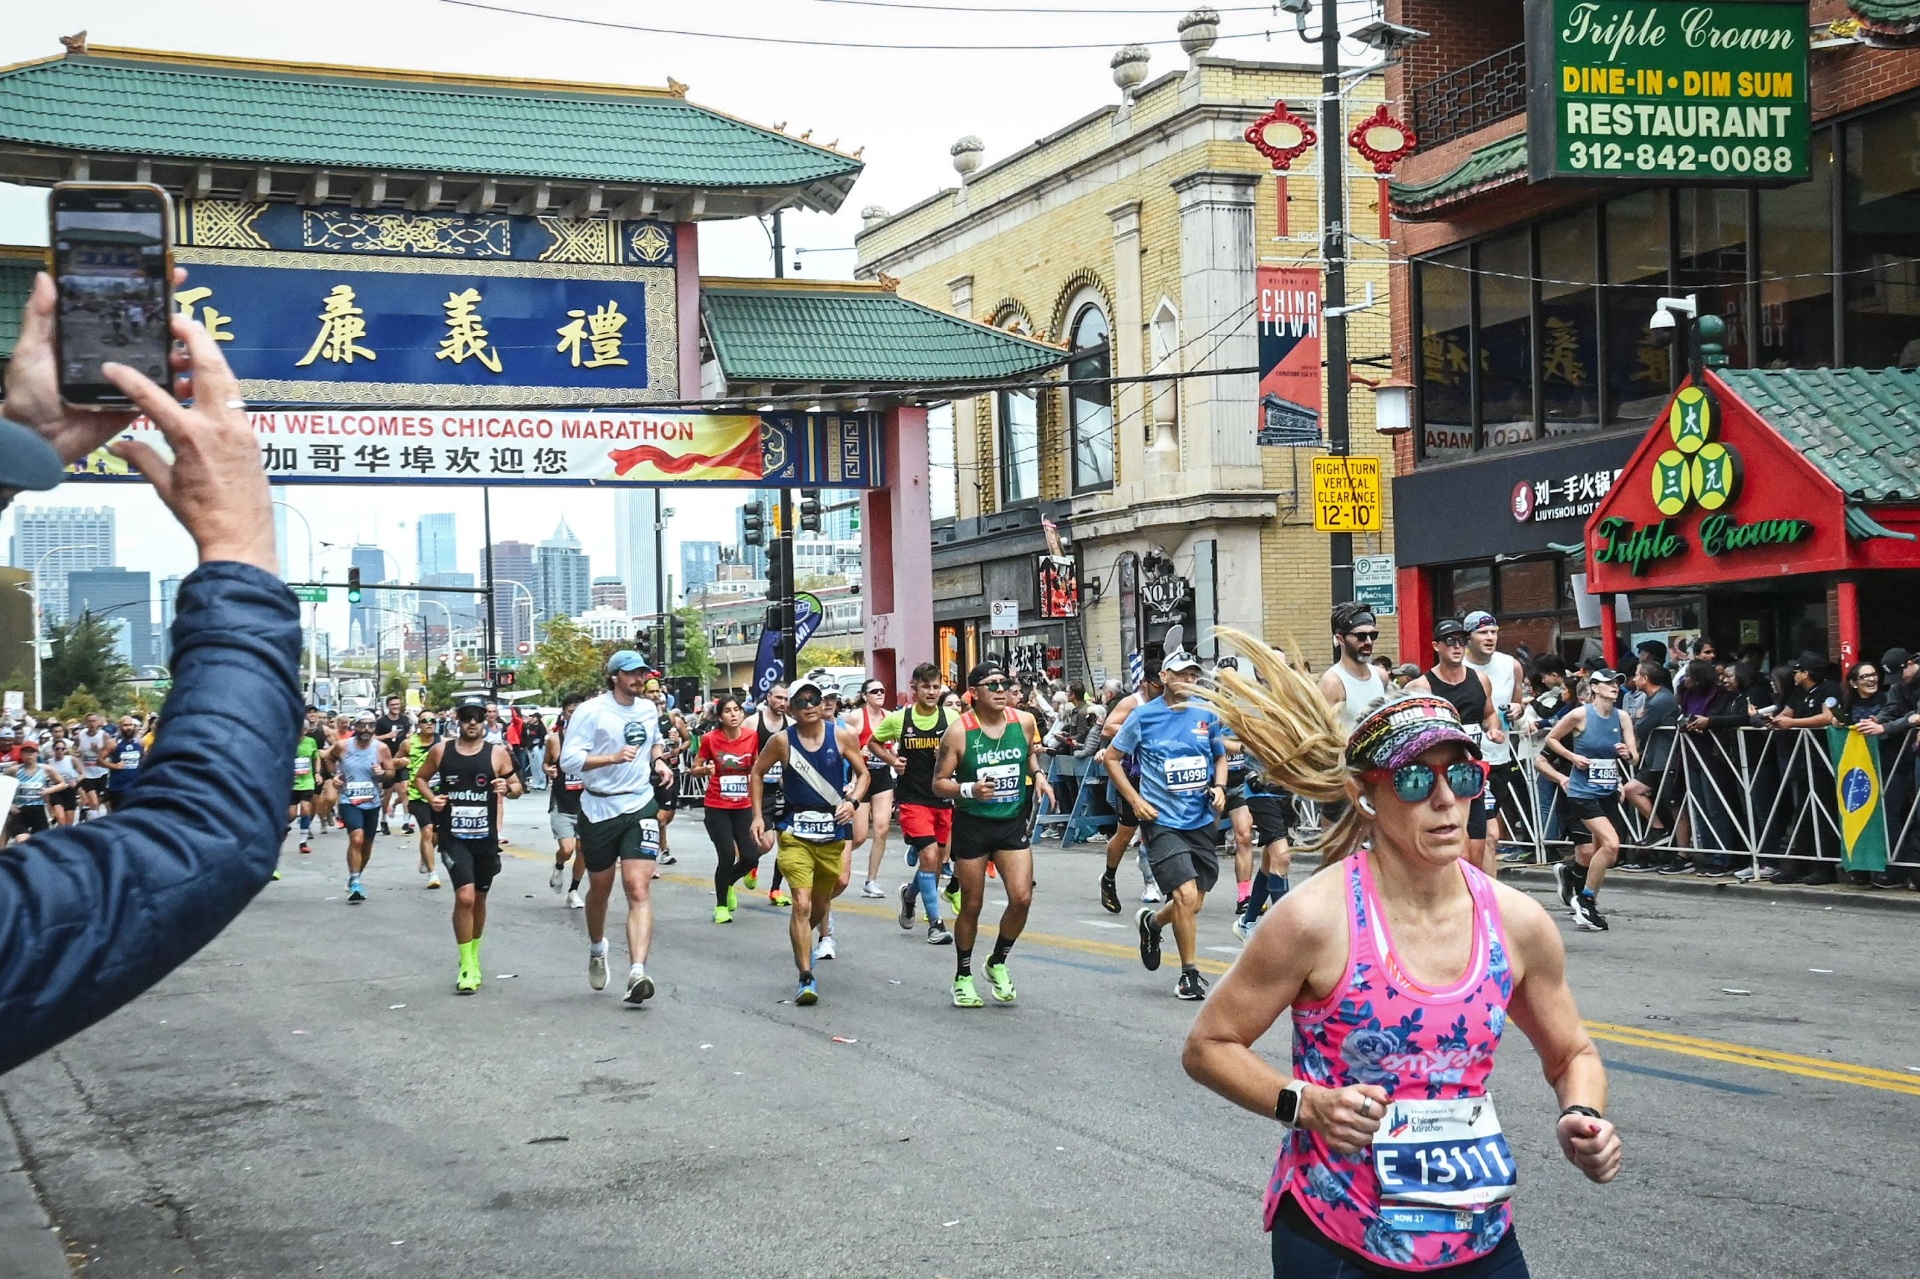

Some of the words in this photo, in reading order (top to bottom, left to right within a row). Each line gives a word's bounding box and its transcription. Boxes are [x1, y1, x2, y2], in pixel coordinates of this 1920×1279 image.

[1562, 3, 1665, 62] Triple
[1680, 7, 1795, 50] Crown
[1563, 66, 1663, 96] DINE-IN
[1683, 71, 1731, 97] DIM
[1737, 72, 1793, 98] SUM
[1567, 102, 1792, 138] RESTAURANT
[1569, 141, 1793, 173] 312-842-0088
[1262, 288, 1317, 314] CHINA
[1262, 312, 1318, 338] TOWN
[285, 414, 434, 437] WELCOMES
[441, 417, 552, 438] CHICAGO
[561, 419, 694, 441] MARATHON
[1683, 406, 1700, 434] 大
[262, 443, 568, 475] 加哥华埠欢迎您
[1316, 463, 1346, 475] RIGHT
[1350, 463, 1376, 475] TURN
[1323, 477, 1370, 489] VERTICAL
[1318, 491, 1376, 503] CLEARANCE
[1322, 505, 1375, 526] 12'-10"
[1535, 505, 1576, 521] LIUYISHOU
[1577, 503, 1593, 516] HOT
[1596, 517, 1681, 576] Triple
[1701, 515, 1804, 557] Crown
[1143, 581, 1185, 603] NO.18
[759, 667, 777, 691] GO
[905, 737, 940, 749] LITHUANI
[977, 748, 1021, 764] MÉXICO
[995, 777, 1019, 789] 3367
[1166, 773, 1175, 783] E
[1177, 769, 1207, 782] 14998
[1590, 769, 1596, 778] E
[448, 790, 487, 801] wefuel
[451, 819, 458, 827] G
[460, 817, 488, 828] 30135
[794, 822, 801, 832] G
[803, 822, 834, 833] 38156
[1412, 1125, 1443, 1133] Marathon
[1377, 1149, 1404, 1185] E
[1415, 1141, 1511, 1186] 13111
[1414, 1214, 1424, 1223] 27
